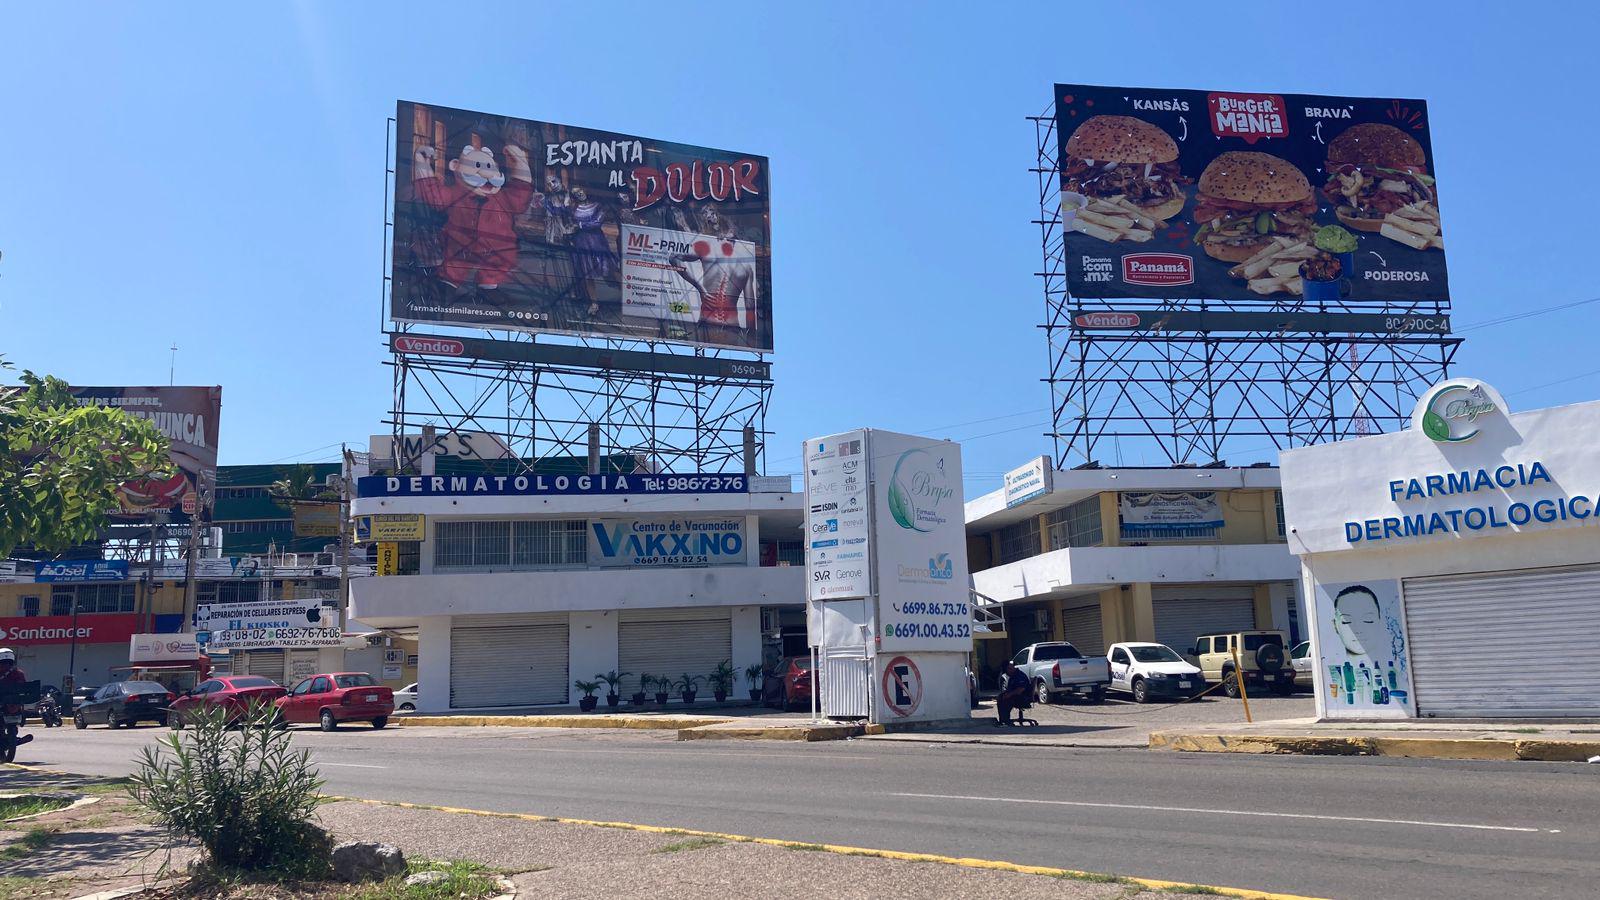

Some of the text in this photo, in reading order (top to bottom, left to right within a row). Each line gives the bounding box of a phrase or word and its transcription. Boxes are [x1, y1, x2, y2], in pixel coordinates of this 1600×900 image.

[1304, 107, 1352, 119] BRAVA
[546, 140, 643, 167] ESPANTA
[608, 169, 627, 188] AL
[631, 158, 760, 212] DOLOR
[628, 232, 690, 254] ML-PRIM
[1364, 270, 1430, 282] PODEROSA
[410, 303, 501, 318] farmaciassimilares.com
[1085, 314, 1133, 327] Vendor
[404, 338, 457, 354] Vendor
[386, 475, 629, 493] DERMATOLOGIA
[641, 477, 664, 491] Tel:
[1389, 461, 1552, 502] FARMACIA
[822, 502, 838, 512] ISDIN
[632, 520, 739, 532] Centro de Vacunación
[641, 555, 708, 565] 669 165 82 54
[814, 570, 831, 582] SVR
[211, 606, 306, 620] REPARACIÓN DE CELULARES EXPRESS
[902, 601, 968, 615] 6699.86.73.76
[247, 620, 289, 630] KIOSKO
[894, 623, 970, 638] 6691.00.43.52
[8, 626, 93, 641] Santander
